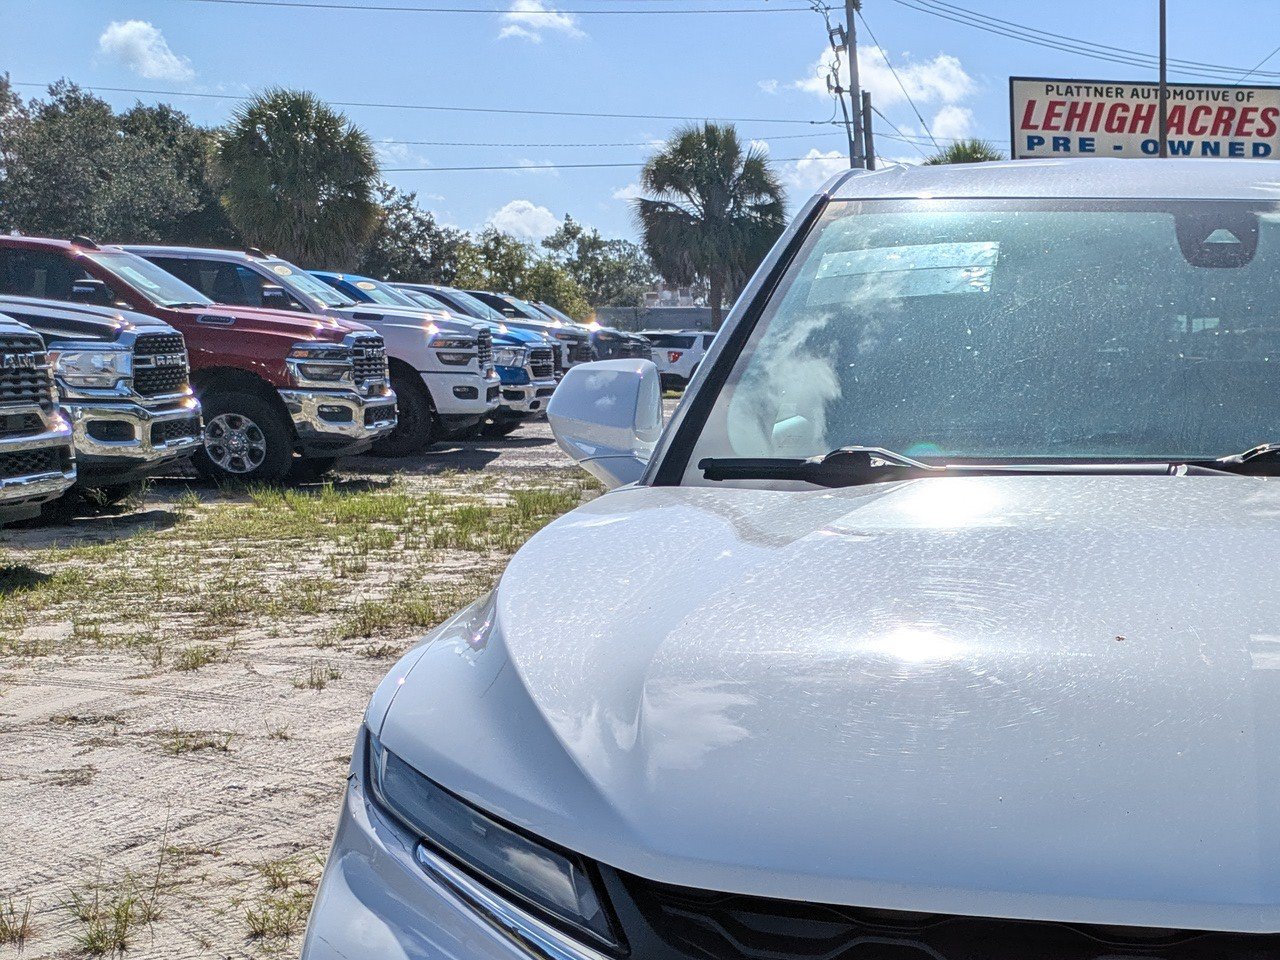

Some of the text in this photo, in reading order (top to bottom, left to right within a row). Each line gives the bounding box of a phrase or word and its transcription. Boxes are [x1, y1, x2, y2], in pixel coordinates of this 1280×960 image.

[1045, 83, 1255, 103] PLATTNER AUTOMOTIVE OF
[1020, 99, 1280, 138] LEHIGH ACRES
[1026, 135, 1096, 153] PRE
[1140, 138, 1272, 158] OWNED
[157, 355, 182, 366] RAM
